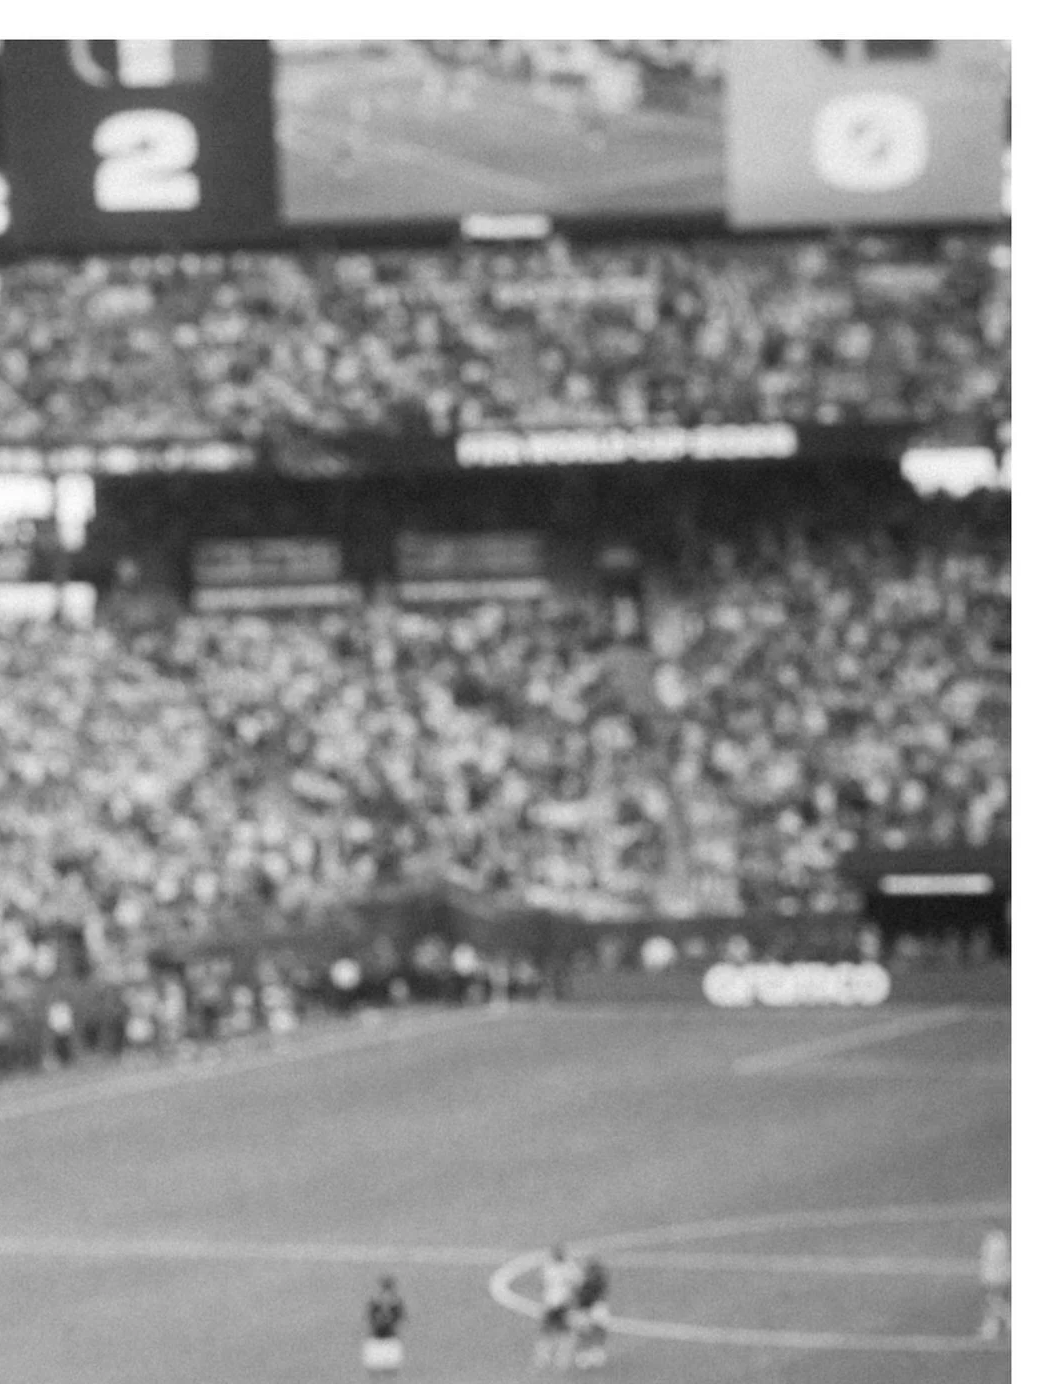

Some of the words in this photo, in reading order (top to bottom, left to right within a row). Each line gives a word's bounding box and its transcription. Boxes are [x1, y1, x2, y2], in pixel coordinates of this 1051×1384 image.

[92, 107, 200, 213] 2
[812, 91, 928, 191] 0
[703, 961, 891, 1007] aramco
